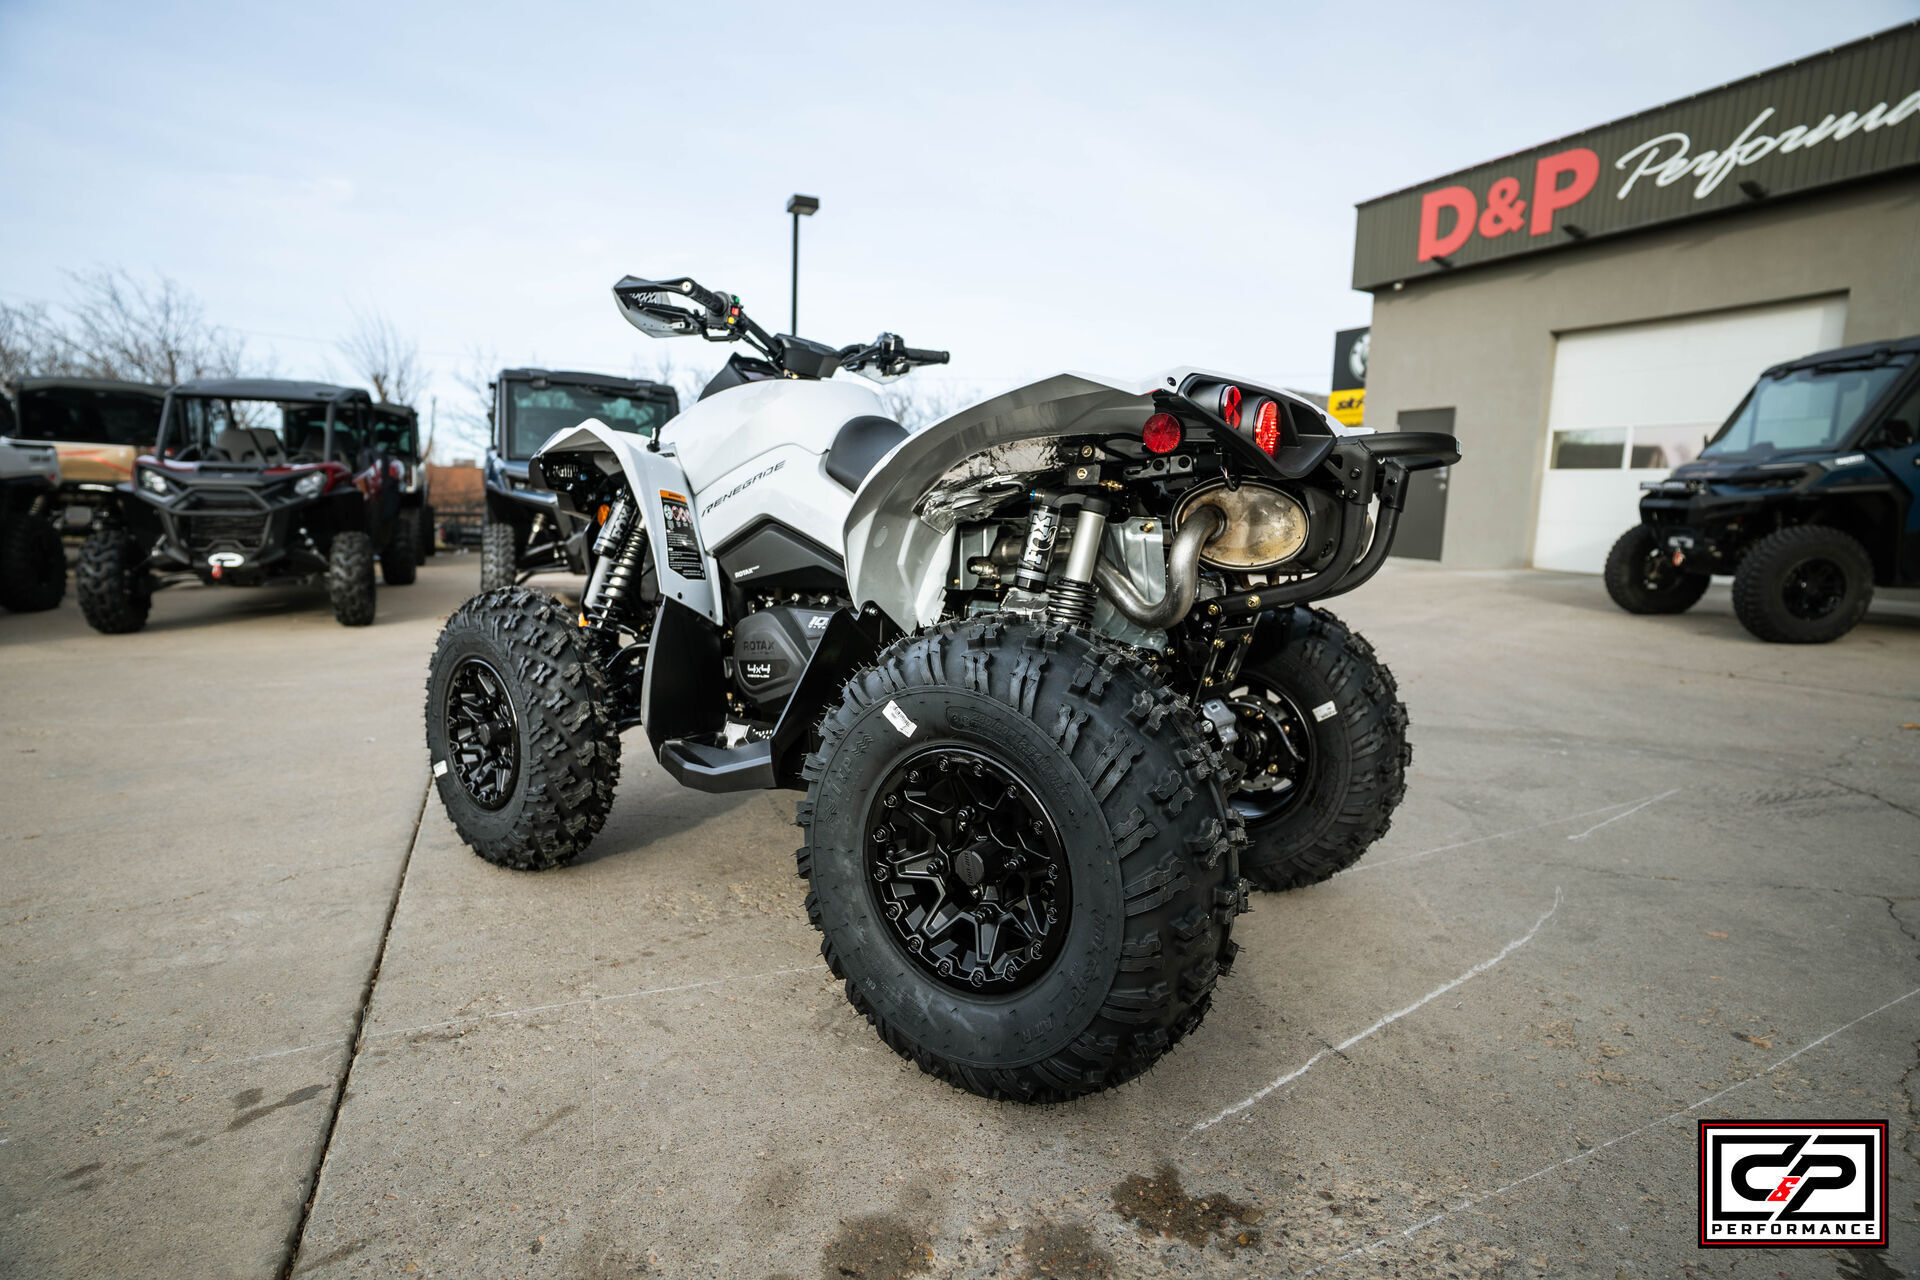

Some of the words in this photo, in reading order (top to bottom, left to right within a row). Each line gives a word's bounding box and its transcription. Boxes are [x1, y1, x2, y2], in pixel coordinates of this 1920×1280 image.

[1418, 148, 1600, 262] D&P
[701, 460, 786, 517] RENEGADE
[1023, 513, 1055, 565] FOX
[743, 640, 775, 651] ROTAX
[747, 664, 770, 674] 4x4
